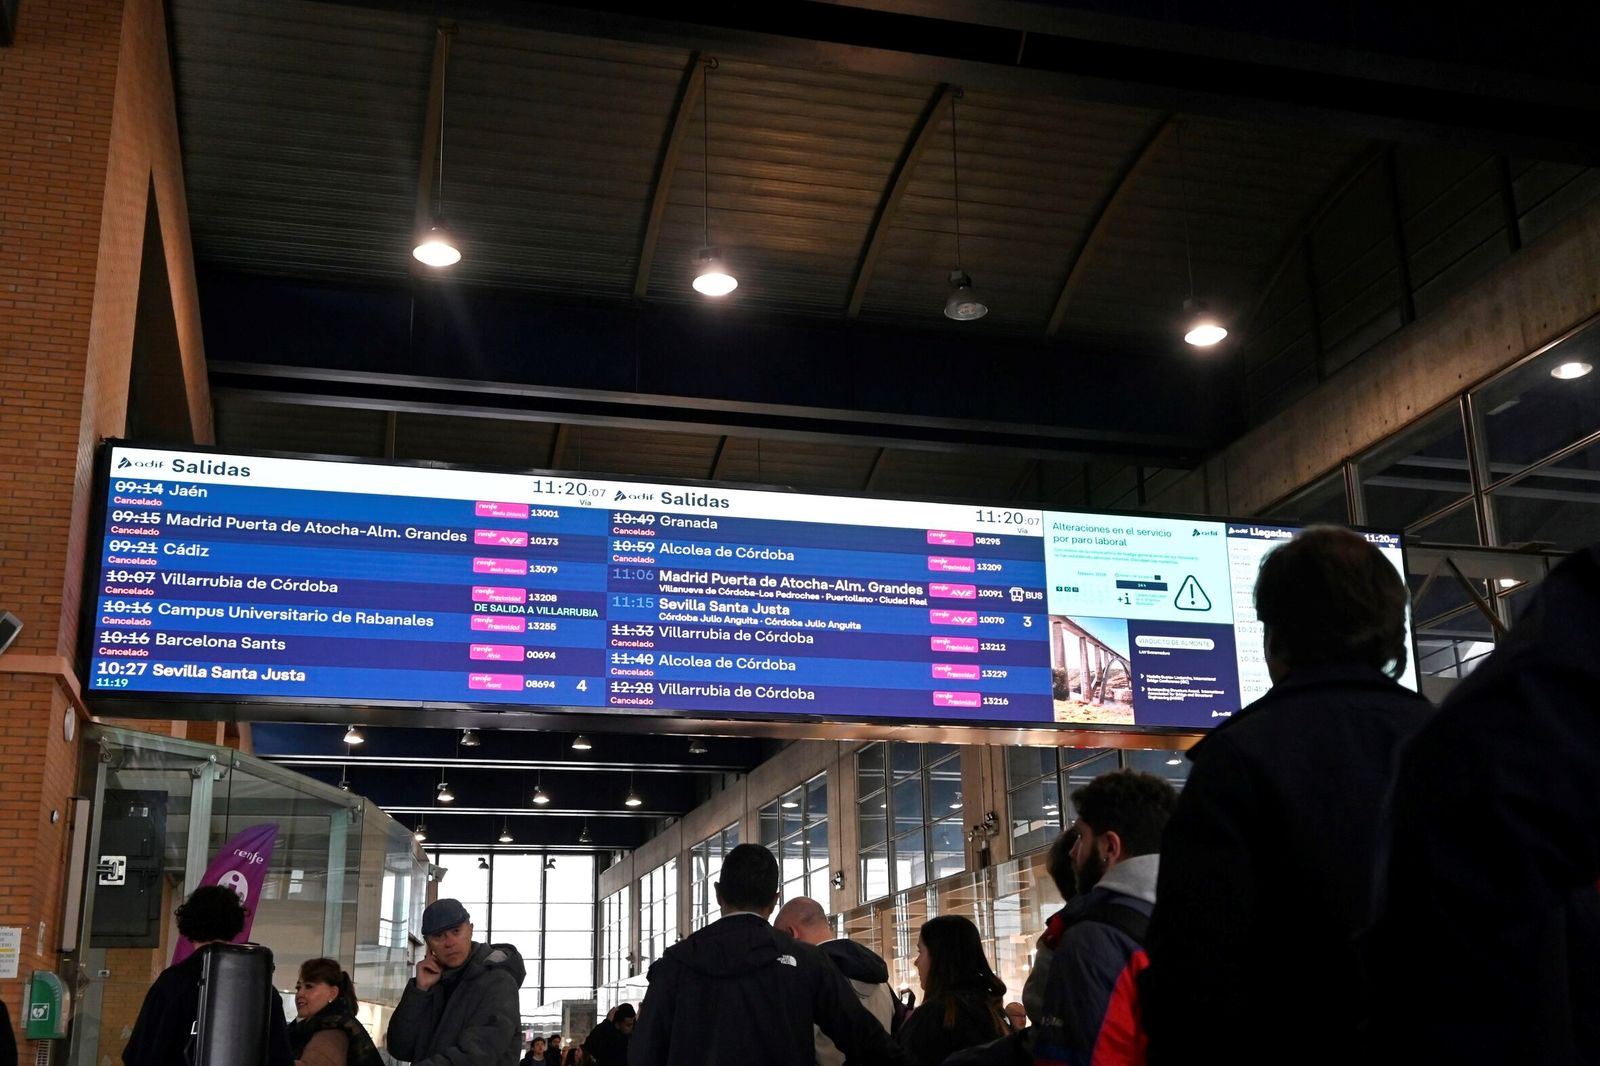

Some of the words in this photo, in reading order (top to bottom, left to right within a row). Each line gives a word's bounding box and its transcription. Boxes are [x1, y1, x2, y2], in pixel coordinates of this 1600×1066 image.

[135, 460, 164, 469] adif
[172, 459, 250, 477] Salidas
[115, 481, 164, 495] 09:14
[169, 484, 207, 497] Jaén
[114, 497, 162, 507] Cancelado
[661, 492, 729, 508] Salidas
[531, 509, 559, 518] 13001
[613, 513, 655, 525] 10:49
[660, 515, 717, 529] Granada
[111, 525, 159, 536] Cancelado
[112, 511, 161, 524] 09:15
[166, 514, 222, 528] Madrid
[226, 517, 277, 532] Puerta
[281, 520, 300, 532] de
[304, 521, 401, 539] Atocha-Alm.
[405, 527, 467, 542] Grandes
[613, 527, 655, 536] Cancelado
[1053, 522, 1110, 534] Alteraciones
[1126, 528, 1134, 536] el
[1137, 529, 1171, 538] servicio
[530, 537, 558, 545] 10173
[976, 537, 1000, 545] 08295
[1095, 536, 1127, 547] laboral
[109, 540, 158, 554] 09:21
[164, 542, 210, 557] Cádiz
[613, 541, 655, 552] 10:59
[660, 543, 711, 557] Alcolea
[715, 546, 732, 558] de
[736, 547, 794, 561] Córdoba
[108, 556, 157, 566] Cancelado
[613, 555, 655, 564] Cancelado
[530, 565, 558, 573] 13079
[977, 563, 1002, 571] 13209
[106, 570, 155, 584] 10:07
[161, 572, 242, 589] Villarrubia
[247, 577, 266, 589] de
[271, 577, 338, 593] Córdoba
[613, 568, 654, 581] 11:06
[659, 571, 708, 583] Madrid
[712, 573, 756, 586] Puerta
[760, 576, 777, 587] de
[780, 577, 865, 592] Atocha-Alm.
[868, 582, 923, 595] Grandes
[105, 586, 154, 596] Cancelado
[659, 584, 703, 593] Villanueva
[718, 588, 774, 597] Córdoba-Los
[776, 590, 820, 600] Pedroches
[826, 593, 873, 603] Puertollano
[879, 596, 908, 604] Ciudad
[910, 598, 928, 606] Real
[978, 590, 1003, 598] 10091
[1025, 592, 1043, 600] BUS
[528, 593, 557, 602] 13208
[490, 604, 525, 613] SALIDA
[527, 606, 534, 614] A
[536, 606, 598, 617] VILLARRUBIA
[613, 596, 653, 608] 11:15
[659, 598, 705, 611] Sevilla
[709, 601, 748, 613] Santa
[752, 603, 790, 615] Justa
[103, 601, 152, 613] 10:16
[158, 602, 224, 619] Campus
[229, 605, 328, 623] Universitario
[332, 610, 352, 623] de
[355, 612, 434, 627] Rabanales
[102, 616, 151, 626] Cancelado
[659, 613, 698, 622] Córdoba
[700, 615, 722, 623] Julio
[724, 616, 758, 625] Anguita
[765, 617, 803, 627] Córdoba
[805, 620, 826, 628] Julio
[828, 621, 861, 630] Anguita
[980, 616, 1004, 624] 10070
[1023, 616, 1032, 627] 3
[528, 622, 556, 631] 13255
[612, 624, 654, 637] 11:33
[659, 626, 730, 641] Villarrubia
[734, 629, 751, 641] de
[755, 630, 813, 644] Córdoba
[100, 631, 150, 644] 10:16
[156, 633, 237, 648] Barcelona
[241, 637, 286, 650] Sants
[611, 639, 654, 648] Cancelado
[99, 647, 148, 657] Cancelado
[981, 643, 1006, 651] 13212
[527, 651, 556, 660] 00694
[611, 653, 654, 665] 11:40
[659, 654, 711, 668] Alcolea
[715, 657, 733, 669] de
[736, 657, 796, 671] Córdoba
[98, 661, 147, 675] 10:27
[153, 663, 207, 679] Sevilla
[211, 666, 257, 680] Santa
[261, 668, 305, 682] Justa
[611, 668, 654, 676] Cancelado
[982, 670, 1007, 678] 13229
[96, 678, 128, 688] 11:19
[526, 680, 555, 688] 08694
[576, 680, 587, 692] 4
[611, 682, 653, 694] 12:28
[659, 682, 731, 698] Villarrubia
[734, 686, 752, 698] de
[755, 687, 815, 700] Córdoba
[611, 697, 653, 706] Cancelado
[983, 697, 1008, 705] 13216
[234, 849, 263, 864] renfe
